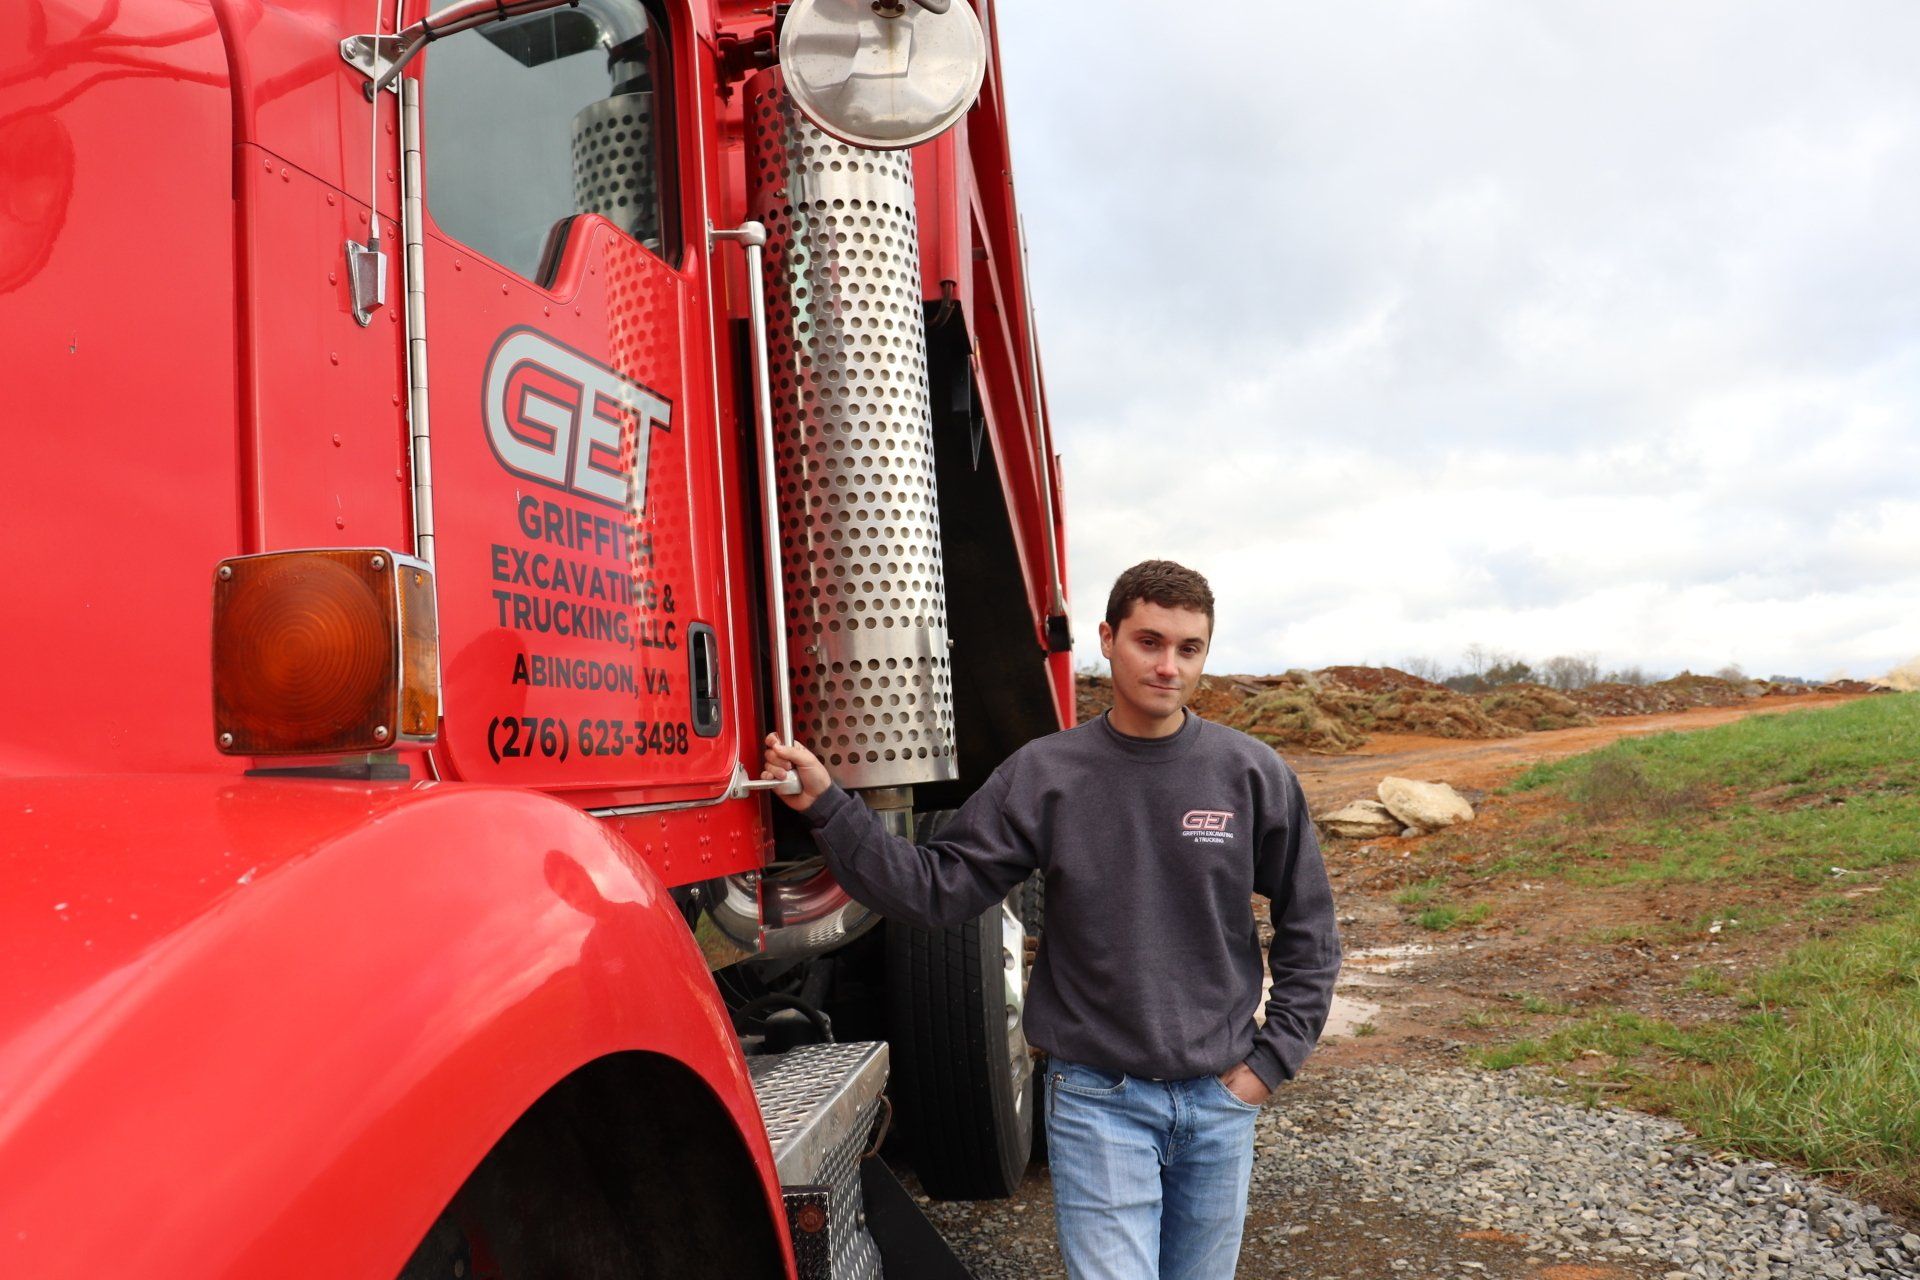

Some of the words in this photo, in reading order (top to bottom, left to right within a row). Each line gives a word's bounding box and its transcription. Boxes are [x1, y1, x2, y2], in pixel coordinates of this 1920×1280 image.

[481, 323, 673, 516] GET
[518, 495, 655, 568] GRIFFITH
[491, 544, 658, 611] EXCAVATING
[662, 584, 675, 614] &
[492, 590, 635, 651] TRUCKING,
[641, 616, 677, 651] LLC
[512, 653, 639, 699] ABINGDON,
[644, 667, 670, 696] VA
[488, 716, 570, 765] (276)
[578, 718, 688, 756] 623-3498
[1182, 809, 1235, 831] GET
